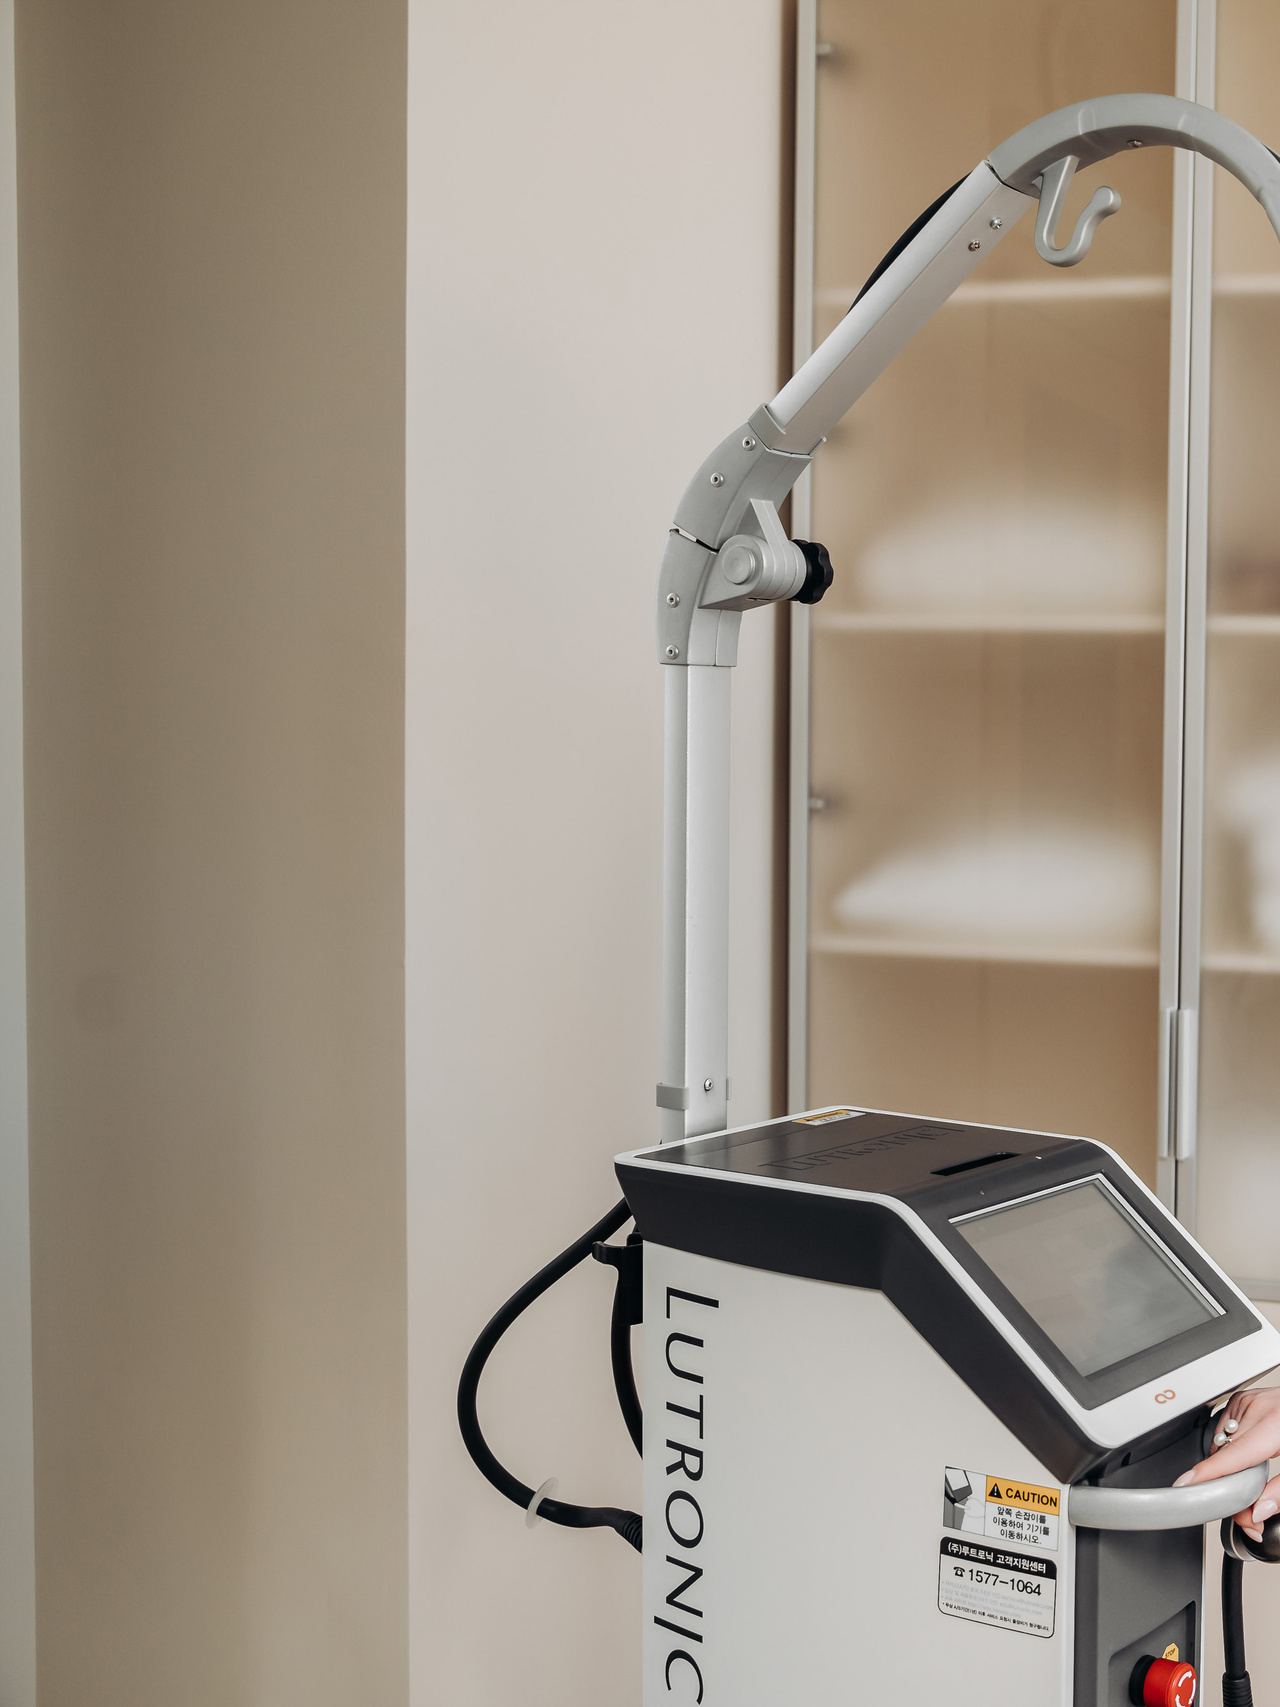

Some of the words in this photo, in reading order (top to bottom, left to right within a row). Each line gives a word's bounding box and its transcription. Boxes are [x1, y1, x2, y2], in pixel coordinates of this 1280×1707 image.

[653, 1286, 720, 1706] LUTRONIC
[1005, 1487, 1058, 1508] CAUTION
[997, 1506, 1012, 1517] 앞쪽
[1015, 1510, 1046, 1524] 손잡이를
[992, 1516, 1024, 1531] 이용하여
[1026, 1523, 1050, 1536] 기기를
[1000, 1528, 1042, 1545] 이동하시오.
[947, 1541, 994, 1563] (주)루트로닉
[996, 1553, 1047, 1574] 고객지원센터
[968, 1568, 1042, 1596] 1577-1064
